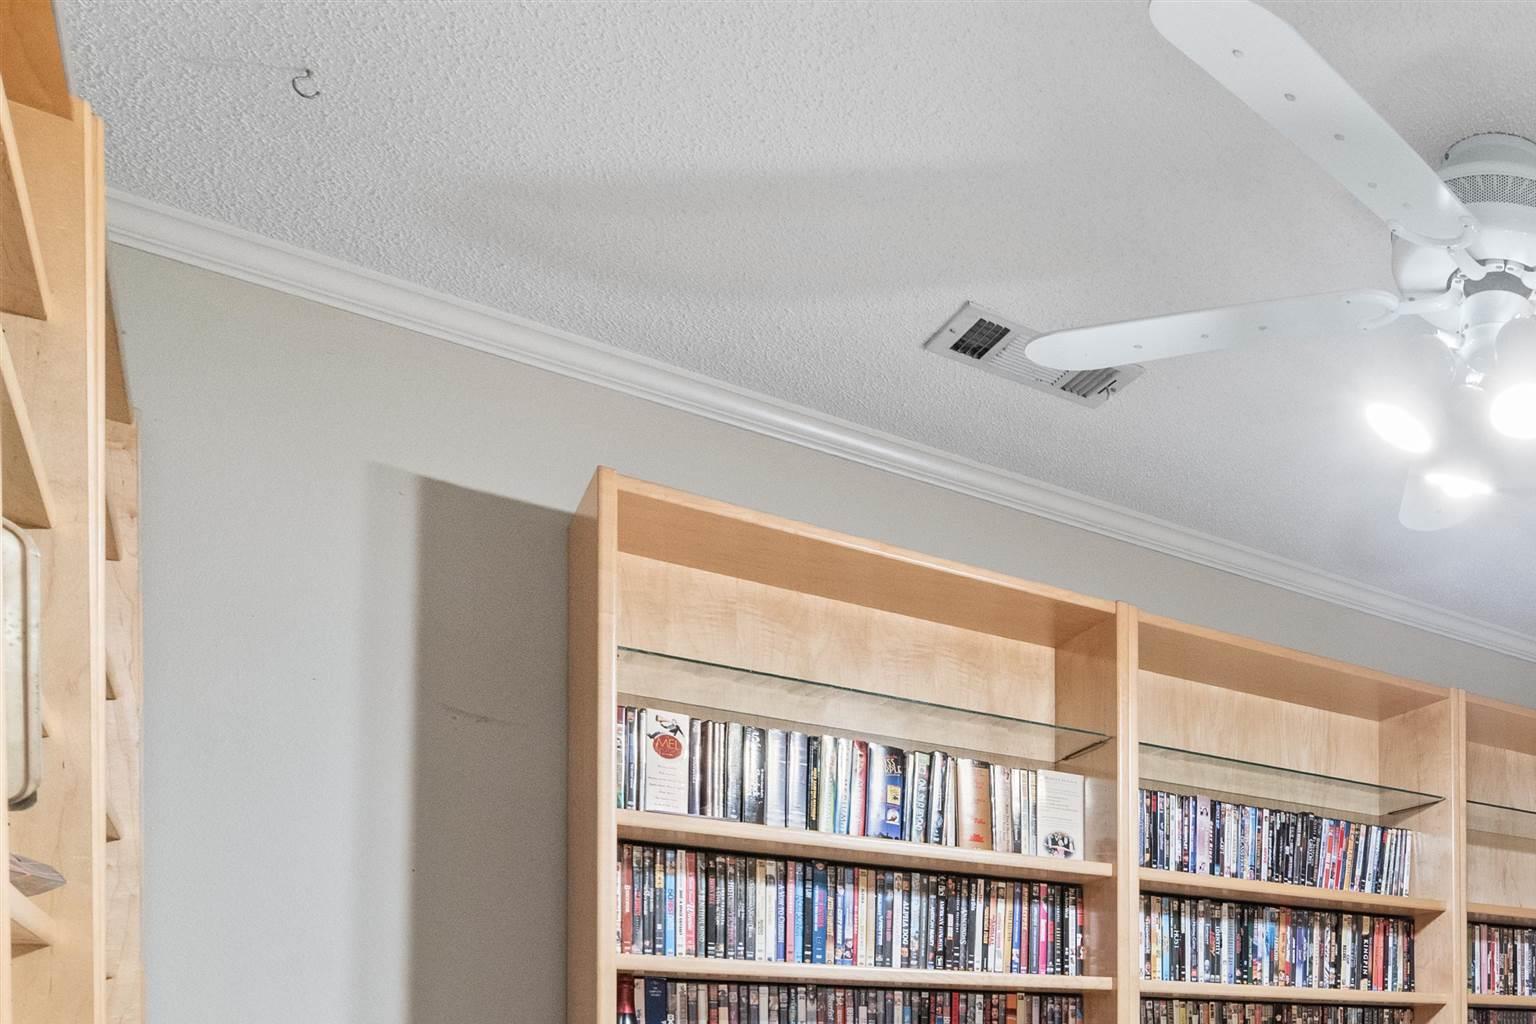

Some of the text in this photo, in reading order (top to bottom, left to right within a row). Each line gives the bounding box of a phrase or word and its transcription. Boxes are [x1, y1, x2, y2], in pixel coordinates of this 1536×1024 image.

[656, 738, 679, 752] MEL
[902, 901, 910, 944] ALPHA DOG
